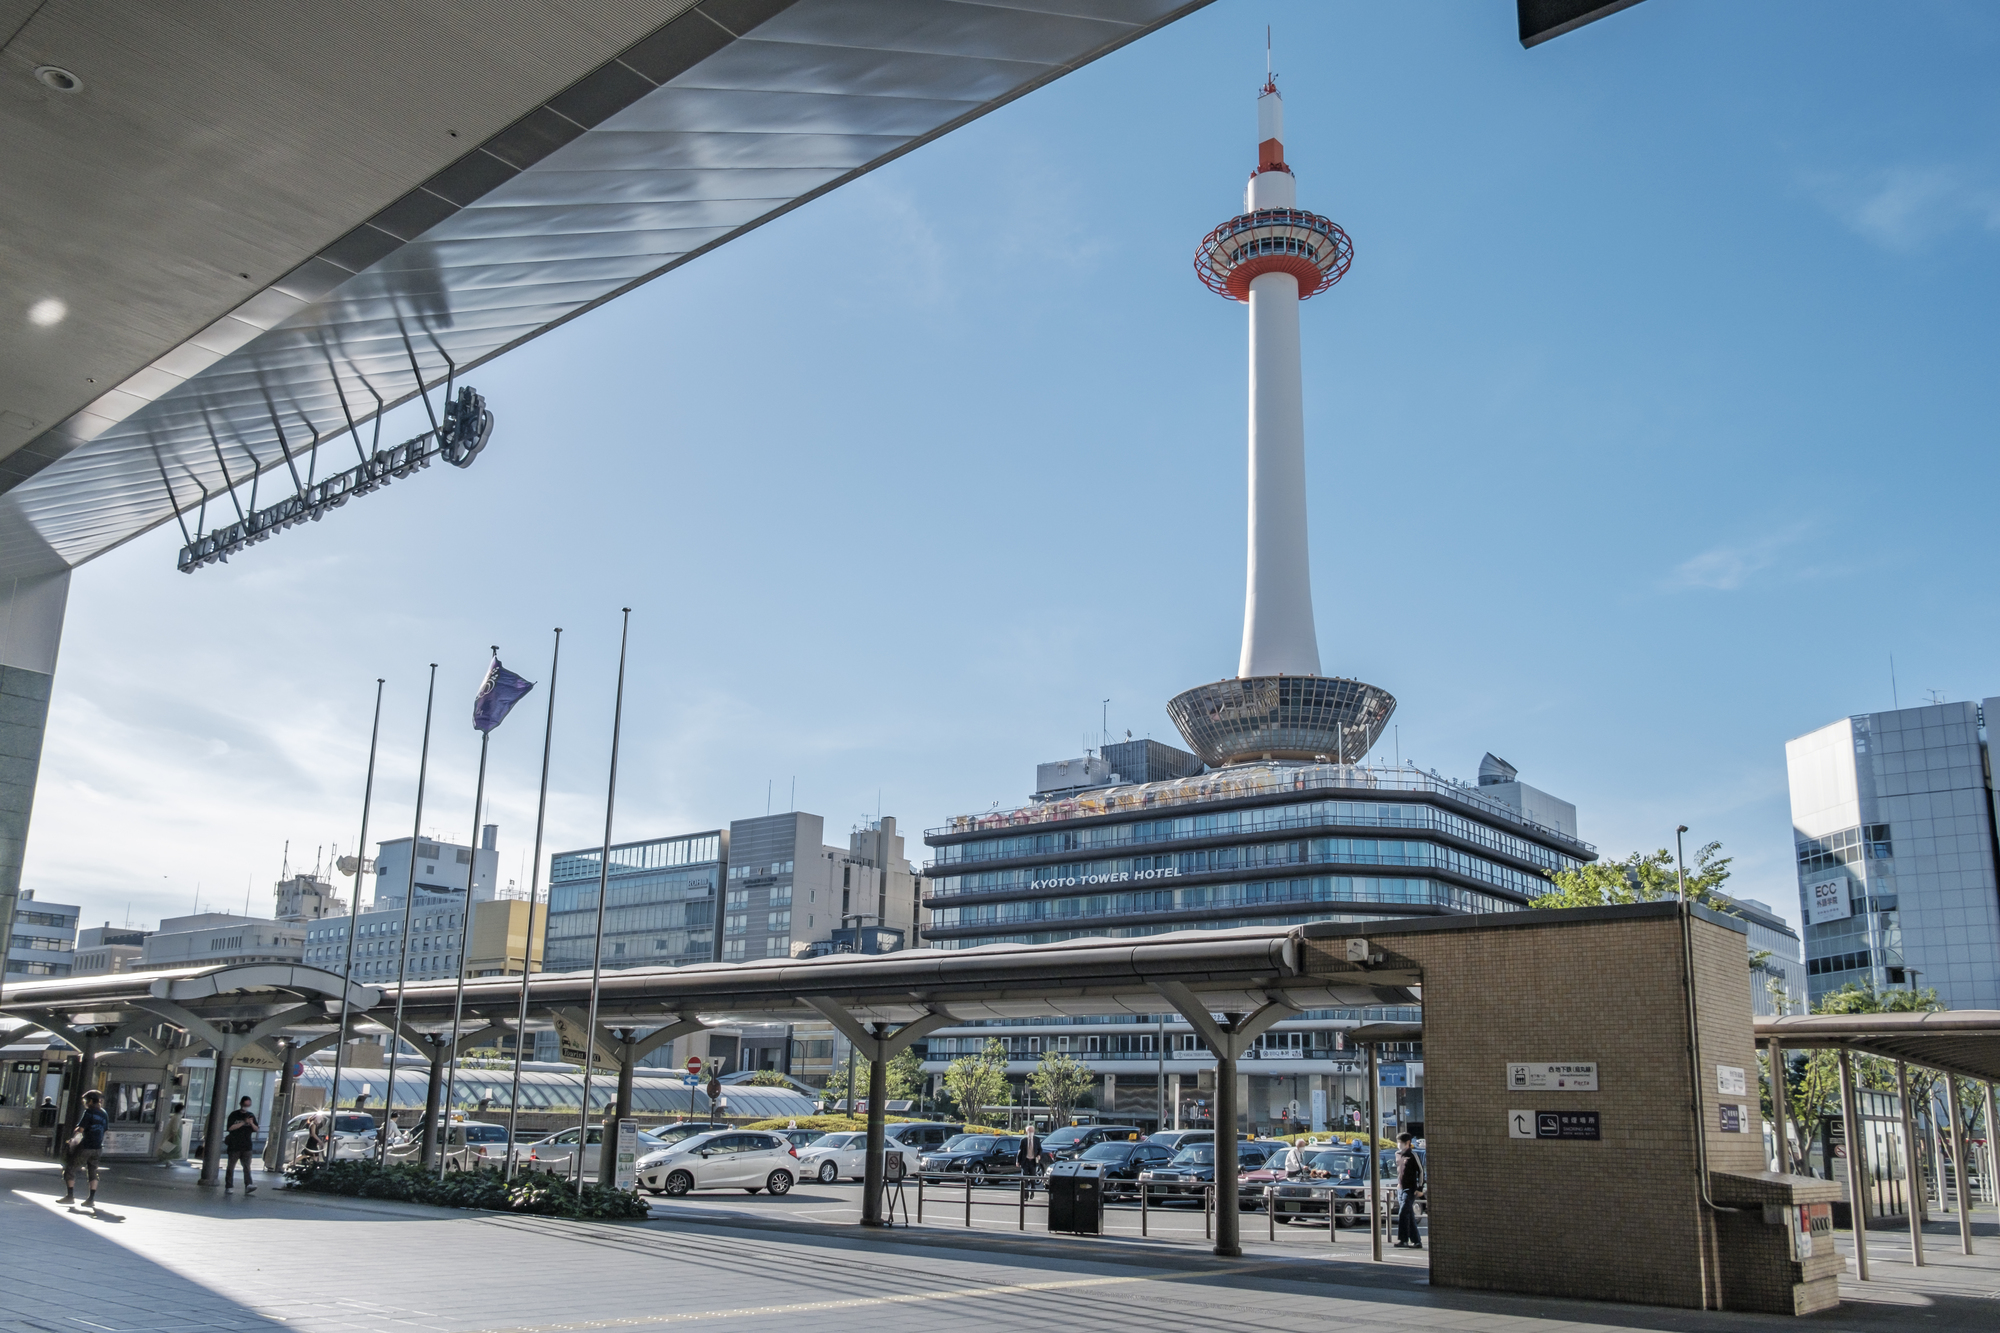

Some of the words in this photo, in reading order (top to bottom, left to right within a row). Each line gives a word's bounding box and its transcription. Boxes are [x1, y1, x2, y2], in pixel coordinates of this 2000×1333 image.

[1030, 877, 1075, 889] KYOTO
[1080, 871, 1128, 885] TOWER
[1134, 867, 1182, 880] HOTEL
[1815, 882, 1837, 898] ECC
